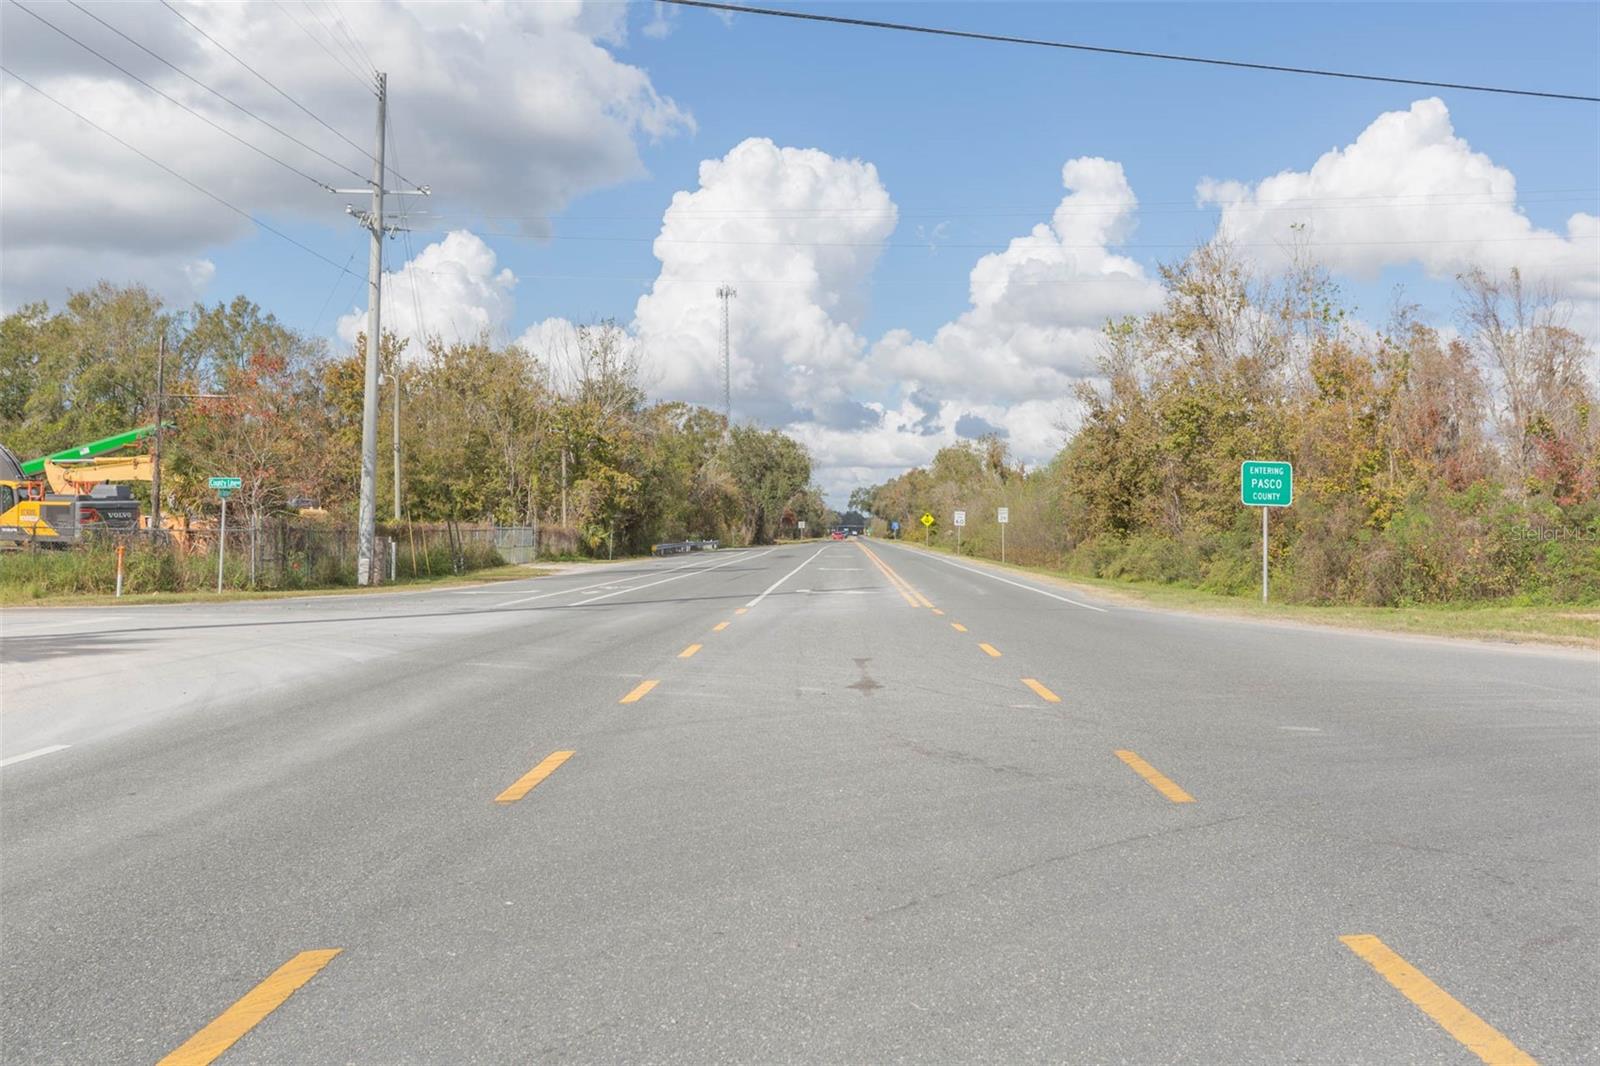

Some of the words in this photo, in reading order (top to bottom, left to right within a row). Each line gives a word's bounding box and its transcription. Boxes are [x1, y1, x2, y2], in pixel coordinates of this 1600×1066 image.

[1250, 466, 1284, 475] ENTERING
[1251, 478, 1282, 489] PASCO
[1252, 492, 1281, 501] COUNTY
